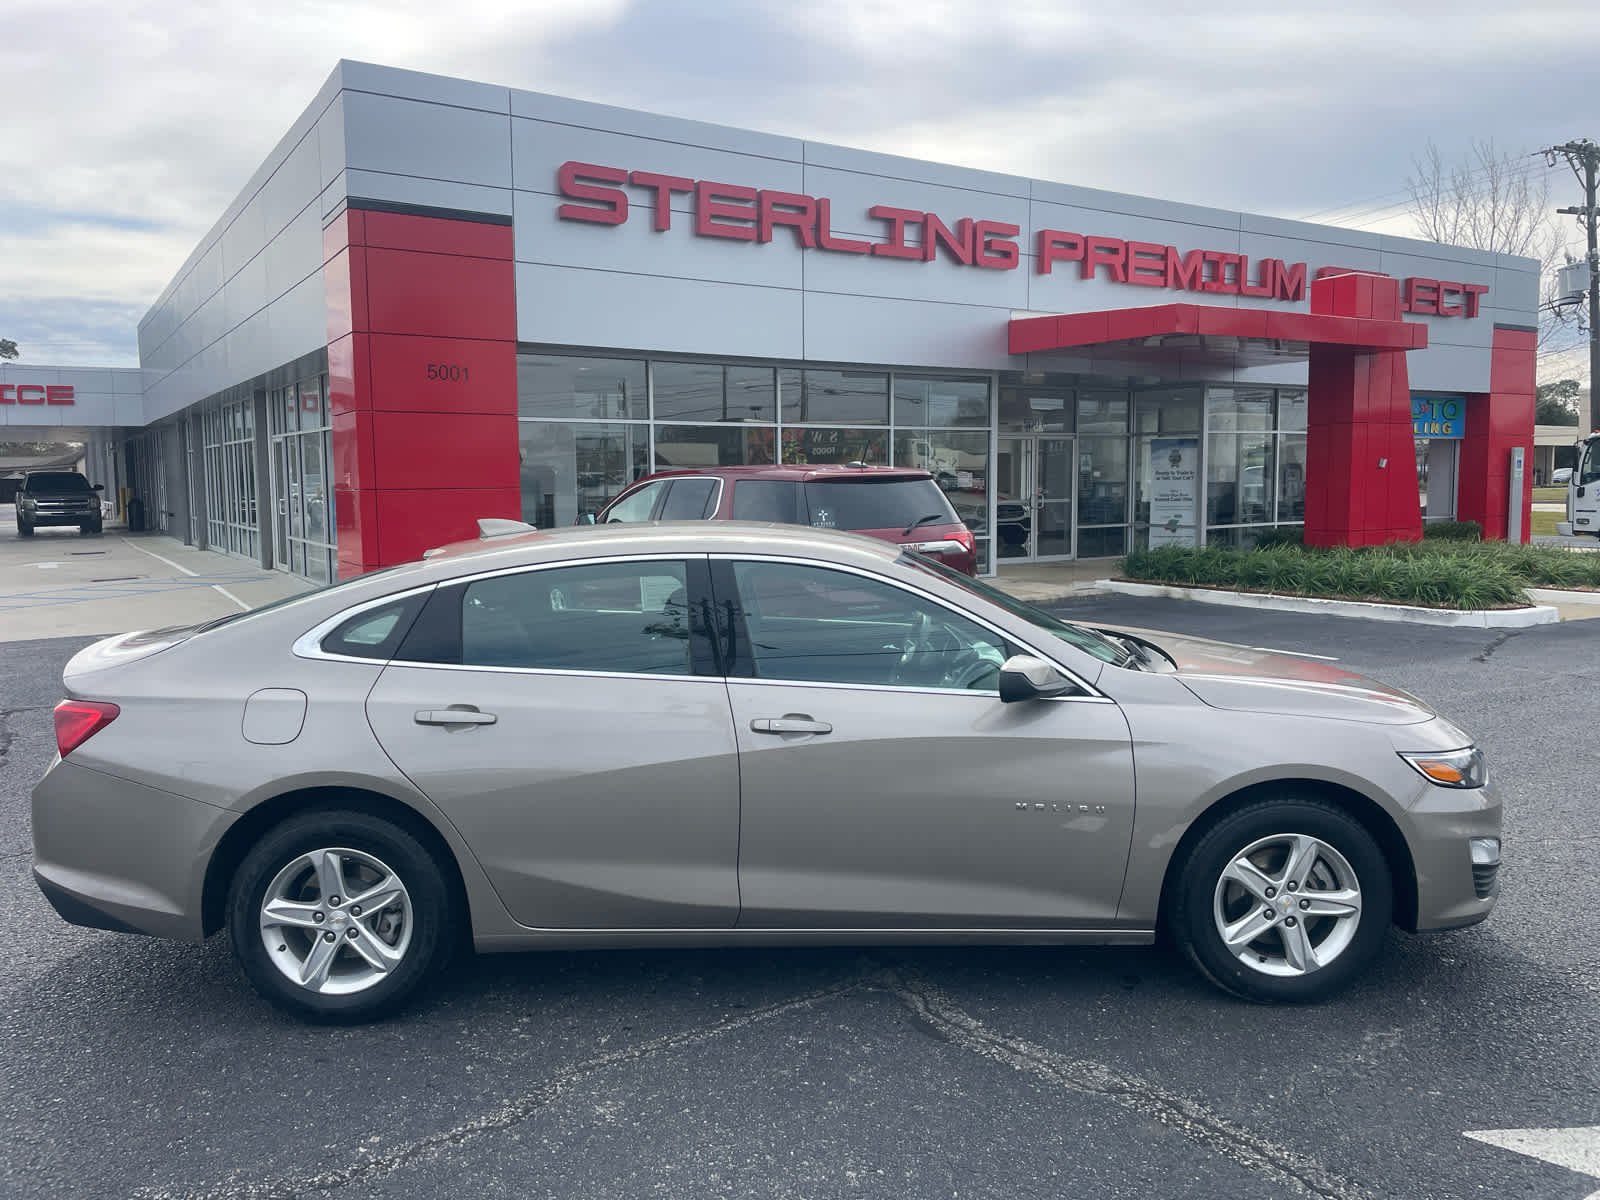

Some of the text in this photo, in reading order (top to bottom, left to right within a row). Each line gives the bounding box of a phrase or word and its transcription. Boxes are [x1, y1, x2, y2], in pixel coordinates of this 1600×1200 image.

[558, 160, 1489, 319] STERLING PREMIUM ECT
[427, 363, 470, 382] 5001
